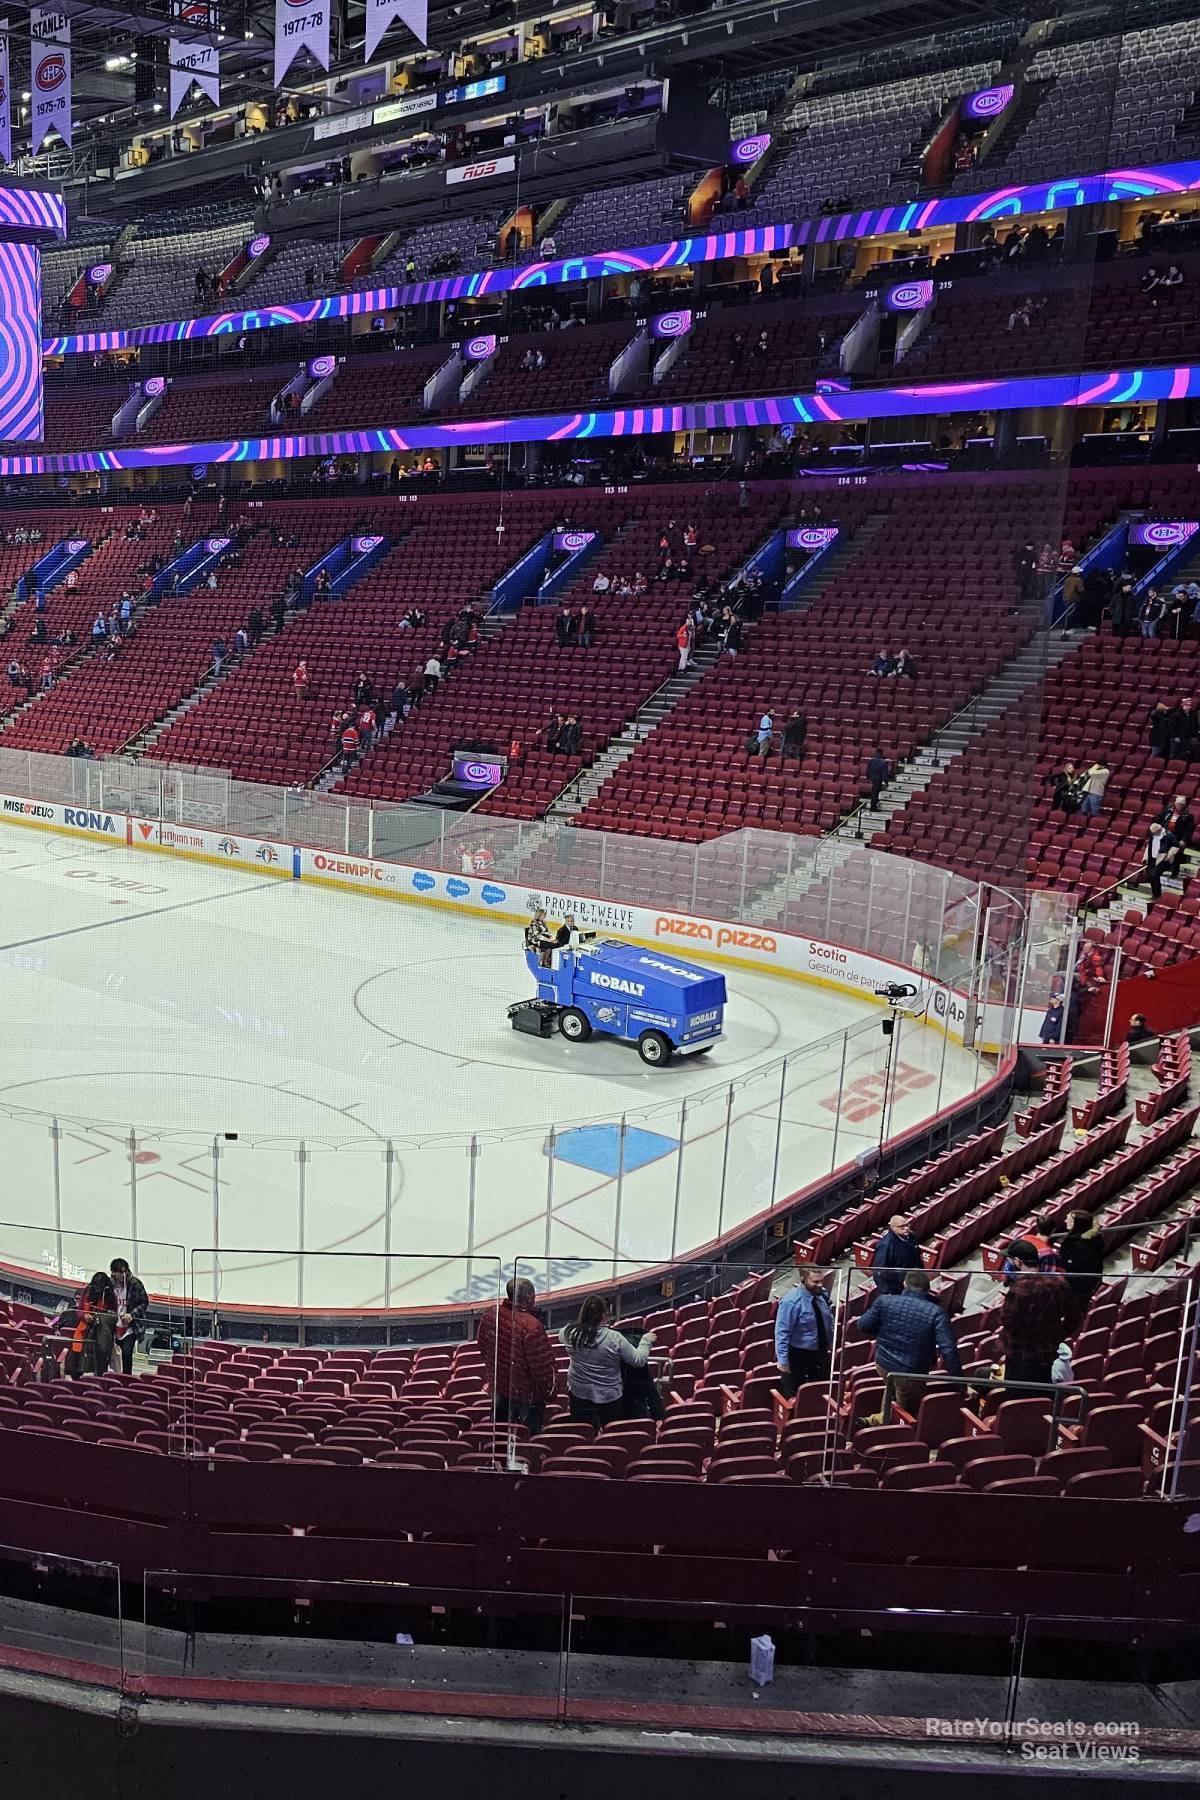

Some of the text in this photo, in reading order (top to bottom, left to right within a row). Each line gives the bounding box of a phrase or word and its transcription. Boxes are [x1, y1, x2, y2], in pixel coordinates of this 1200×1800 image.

[32, 14, 68, 38] STANLEY
[283, 12, 323, 37] 1977-78
[36, 96, 66, 116] 1975-76
[463, 161, 497, 179] RDS
[865, 281, 952, 298] 214 215
[64, 808, 116, 833] RONA
[189, 833, 204, 848] TIRE
[582, 915, 634, 931] WHISKEY
[591, 902, 633, 923] TWELVE
[655, 917, 777, 953] pizza pizza
[809, 942, 847, 964] Scotia
[639, 956, 704, 981] RONA
[808, 958, 844, 979] Gestion
[846, 969, 858, 981] de
[591, 971, 645, 996] KOBALT
[690, 1010, 718, 1027] KOBALT
[819, 1061, 937, 1123] RDS
[1152, 1447, 1160, 1457] G
